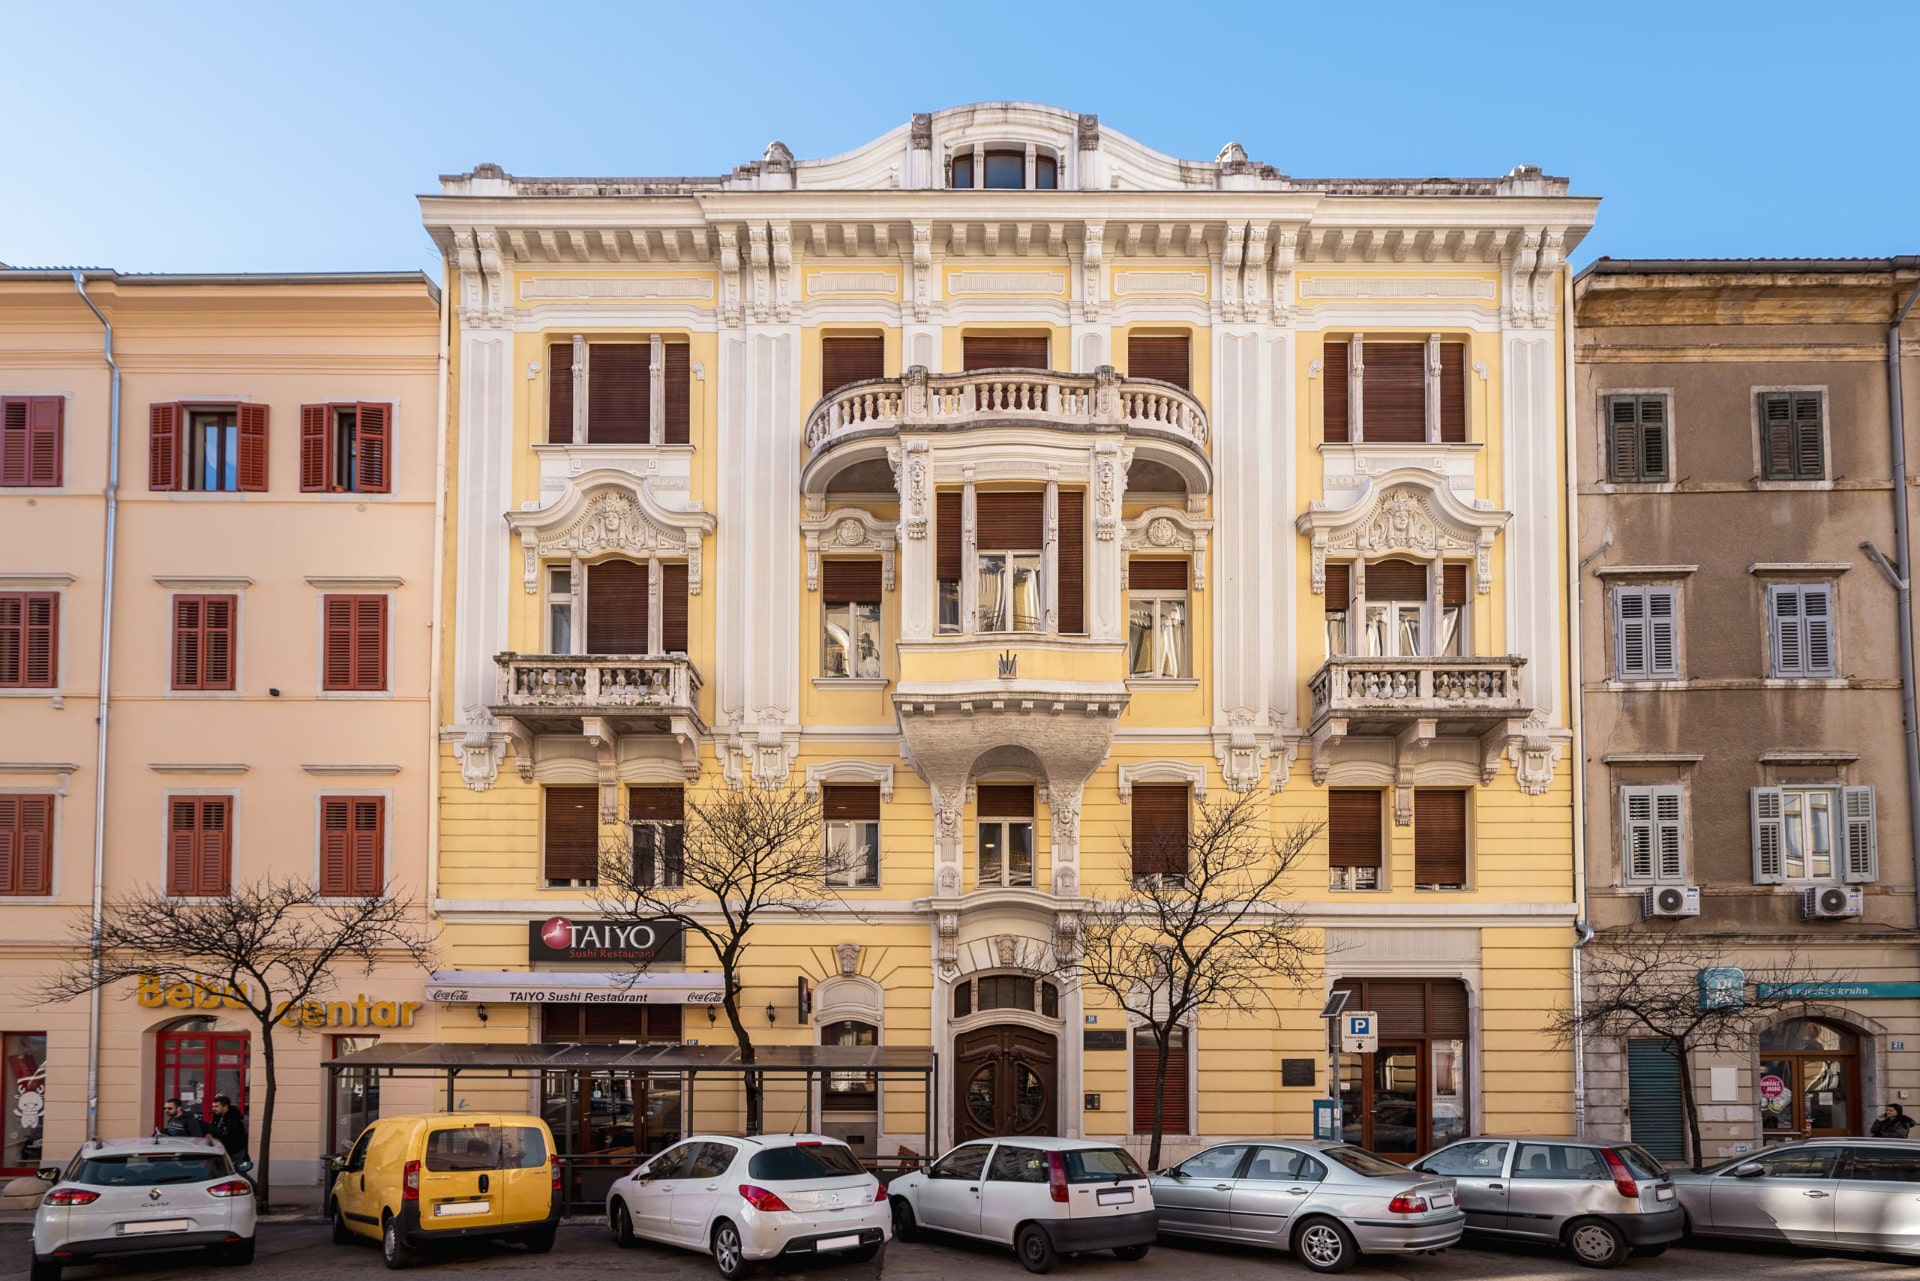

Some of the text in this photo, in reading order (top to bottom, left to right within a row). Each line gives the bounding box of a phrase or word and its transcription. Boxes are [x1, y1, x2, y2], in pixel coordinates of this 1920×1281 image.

[566, 925, 656, 949] TAIYO
[569, 949, 597, 958] Sushi
[137, 972, 251, 1009] Beba
[509, 991, 649, 1003] TAIYO Sushi Restaurant
[1838, 986, 1869, 996] kruha
[275, 992, 423, 1028] centar
[1355, 1019, 1367, 1033] P
